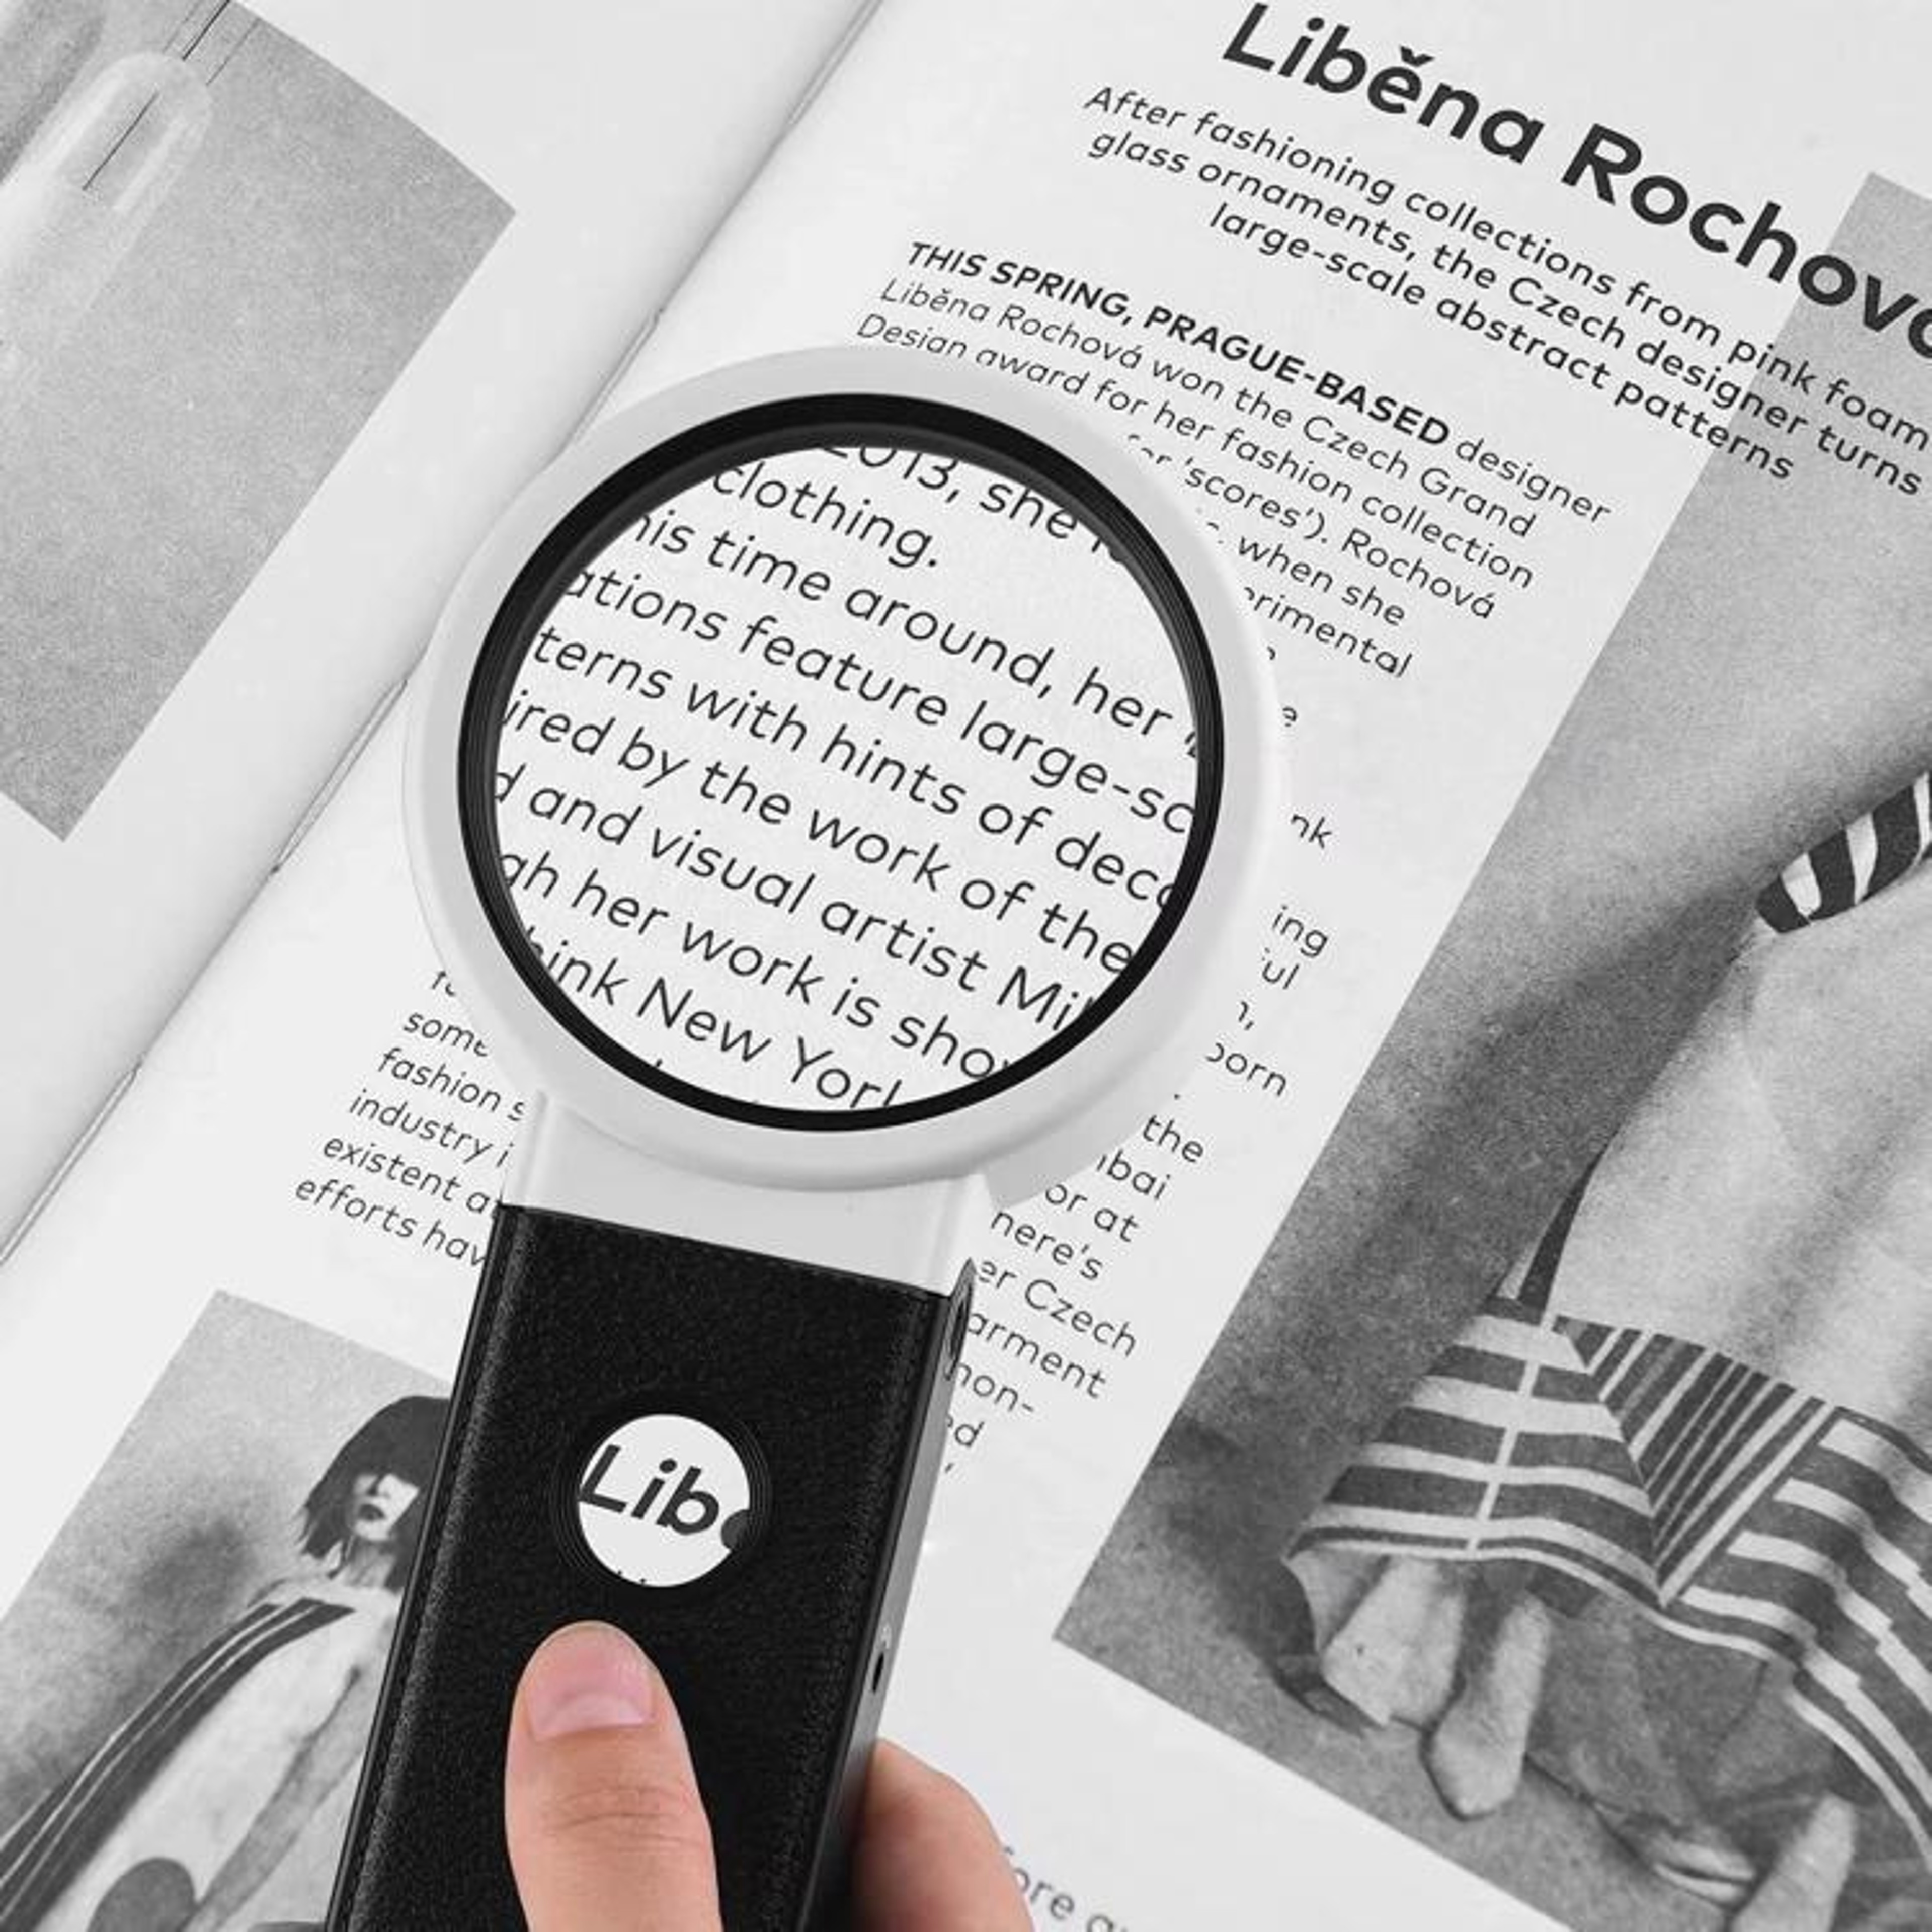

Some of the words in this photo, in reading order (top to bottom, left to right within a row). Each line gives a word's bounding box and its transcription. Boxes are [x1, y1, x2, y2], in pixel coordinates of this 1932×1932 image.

[1223, 2, 1545, 165] Liběna
[1084, 87, 1187, 128] After
[1194, 111, 1395, 205] fashioning
[1406, 193, 1616, 295] collections
[1625, 281, 1721, 347] from
[1728, 339, 1817, 394] pink
[1824, 379, 1928, 450] foam
[1088, 133, 1189, 173] glass
[1199, 165, 1415, 261] ornaments,
[1433, 244, 1496, 288] the
[1509, 277, 1625, 349] Czech
[1637, 341, 1808, 435] designer
[1818, 425, 1922, 496] turns
[907, 242, 987, 276] THIS
[991, 261, 1132, 325] SPRING,
[1144, 305, 1449, 445] PRAGUE-BASED
[1456, 438, 1611, 523] designer
[1210, 203, 1425, 305] large-scale
[1437, 299, 1610, 389] abstract
[1615, 381, 1793, 479] patterns
[880, 279, 990, 322] Liběna
[997, 305, 1142, 369] Rochová
[1153, 360, 1224, 400] won
[1235, 388, 1293, 429] the
[1303, 416, 1408, 480] Czech
[1420, 468, 1537, 537] Grand
[713, 462, 937, 568] clothing.
[976, 349, 1090, 395] award
[1094, 380, 1148, 416] for
[1154, 402, 1215, 442] her
[1221, 429, 1352, 504] fashion
[1361, 495, 1533, 589] collection
[980, 484, 1078, 538] she
[1185, 457, 1328, 543] 'scores').
[1342, 528, 1496, 619] Rochová
[1238, 536, 1333, 594] when
[1342, 584, 1405, 625] she
[708, 531, 830, 600] time
[846, 590, 1054, 699] around,
[1073, 667, 1173, 735] her
[740, 615, 947, 725] feature
[533, 628, 673, 698] terns
[687, 683, 807, 752] with
[821, 724, 966, 815] hints
[979, 804, 1053, 844] of
[618, 727, 691, 788] by
[700, 762, 791, 824] the
[808, 810, 950, 892] work
[960, 879, 1035, 920] of
[1039, 904, 1132, 972] the
[529, 788, 642, 845] and
[652, 828, 816, 914] visual
[821, 901, 987, 992] artist
[997, 966, 1093, 1030] Mi
[1271, 906, 1328, 957] ing
[572, 869, 669, 934] her
[682, 922, 823, 1004] work
[832, 977, 880, 1027] is
[891, 1015, 1008, 1079] sho
[637, 977, 772, 1062] New
[350, 1089, 492, 1164] industry
[378, 1047, 501, 1111] fashion
[323, 1137, 461, 1201] existent
[1096, 1149, 1171, 1199] bai
[1142, 1115, 1203, 1163] the
[295, 1178, 417, 1238] efforts
[1094, 1207, 1139, 1242] at
[1024, 1279, 1136, 1357] Czech
